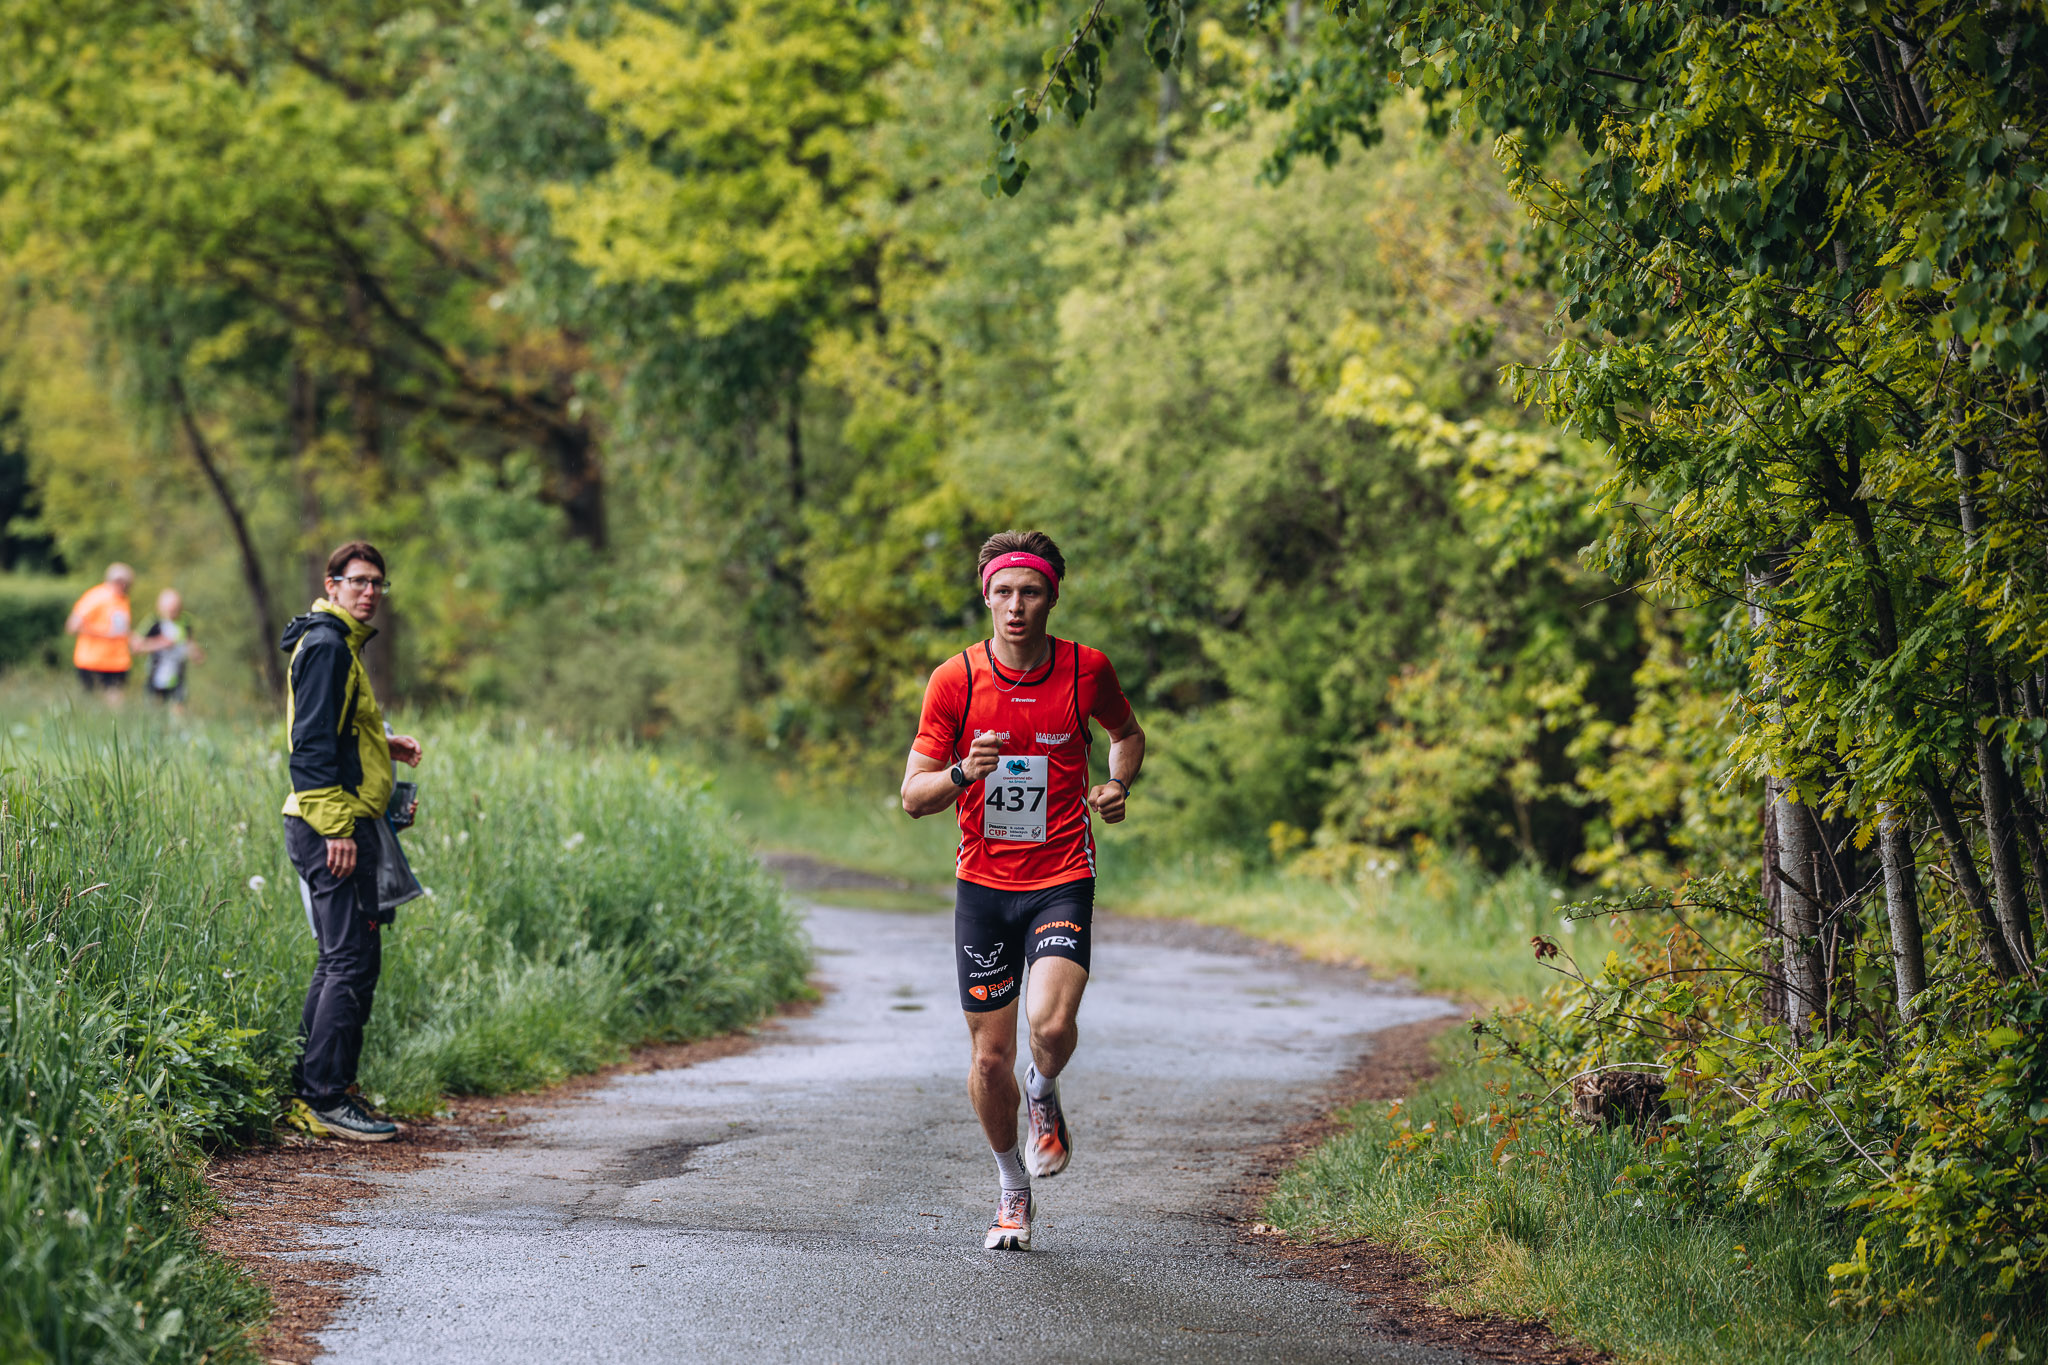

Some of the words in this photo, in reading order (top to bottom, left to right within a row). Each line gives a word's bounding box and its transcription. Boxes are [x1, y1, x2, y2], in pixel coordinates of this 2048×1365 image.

[1036, 732, 1071, 740] MARATON
[986, 786, 1046, 812] 437
[1035, 935, 1078, 953] ATEX
[969, 964, 1009, 979] DYNAFIT
[988, 976, 1014, 992] Reha
